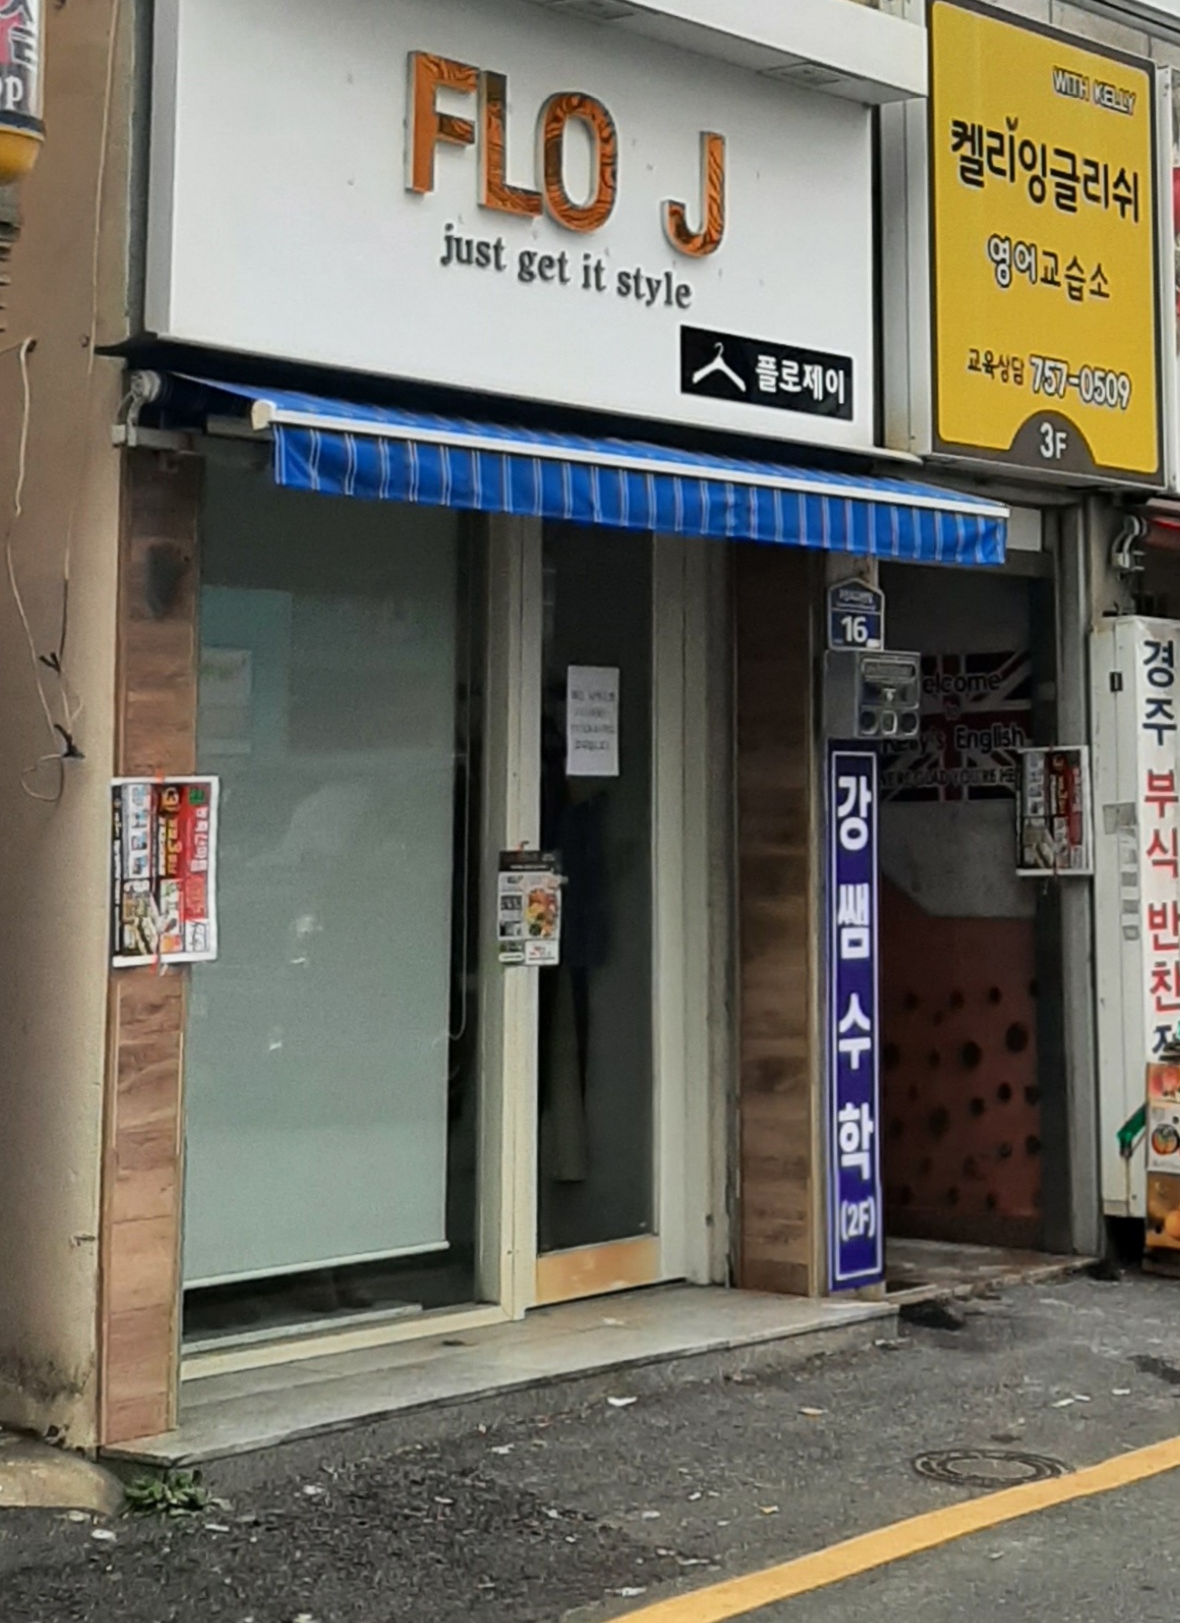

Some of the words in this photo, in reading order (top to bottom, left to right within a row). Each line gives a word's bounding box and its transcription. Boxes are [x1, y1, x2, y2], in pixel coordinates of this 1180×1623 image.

[1053, 66, 1090, 99] WITH
[1094, 79, 1136, 115] KELLY
[404, 49, 618, 235] FLO
[661, 130, 727, 259] J
[951, 117, 1140, 223] 켈리잉글리쉬
[440, 223, 506, 272] just
[518, 247, 571, 285] get
[582, 253, 608, 292] it
[616, 266, 693, 309] style
[755, 353, 846, 406] 플로제이
[1029, 353, 1132, 410] 757-0509
[1039, 421, 1068, 461] 3F
[841, 615, 869, 644] 16
[922, 670, 1001, 696] elcome
[955, 722, 1026, 753] English
[1144, 768, 1180, 879] 부식
[840, 1197, 876, 1239] (2F)
